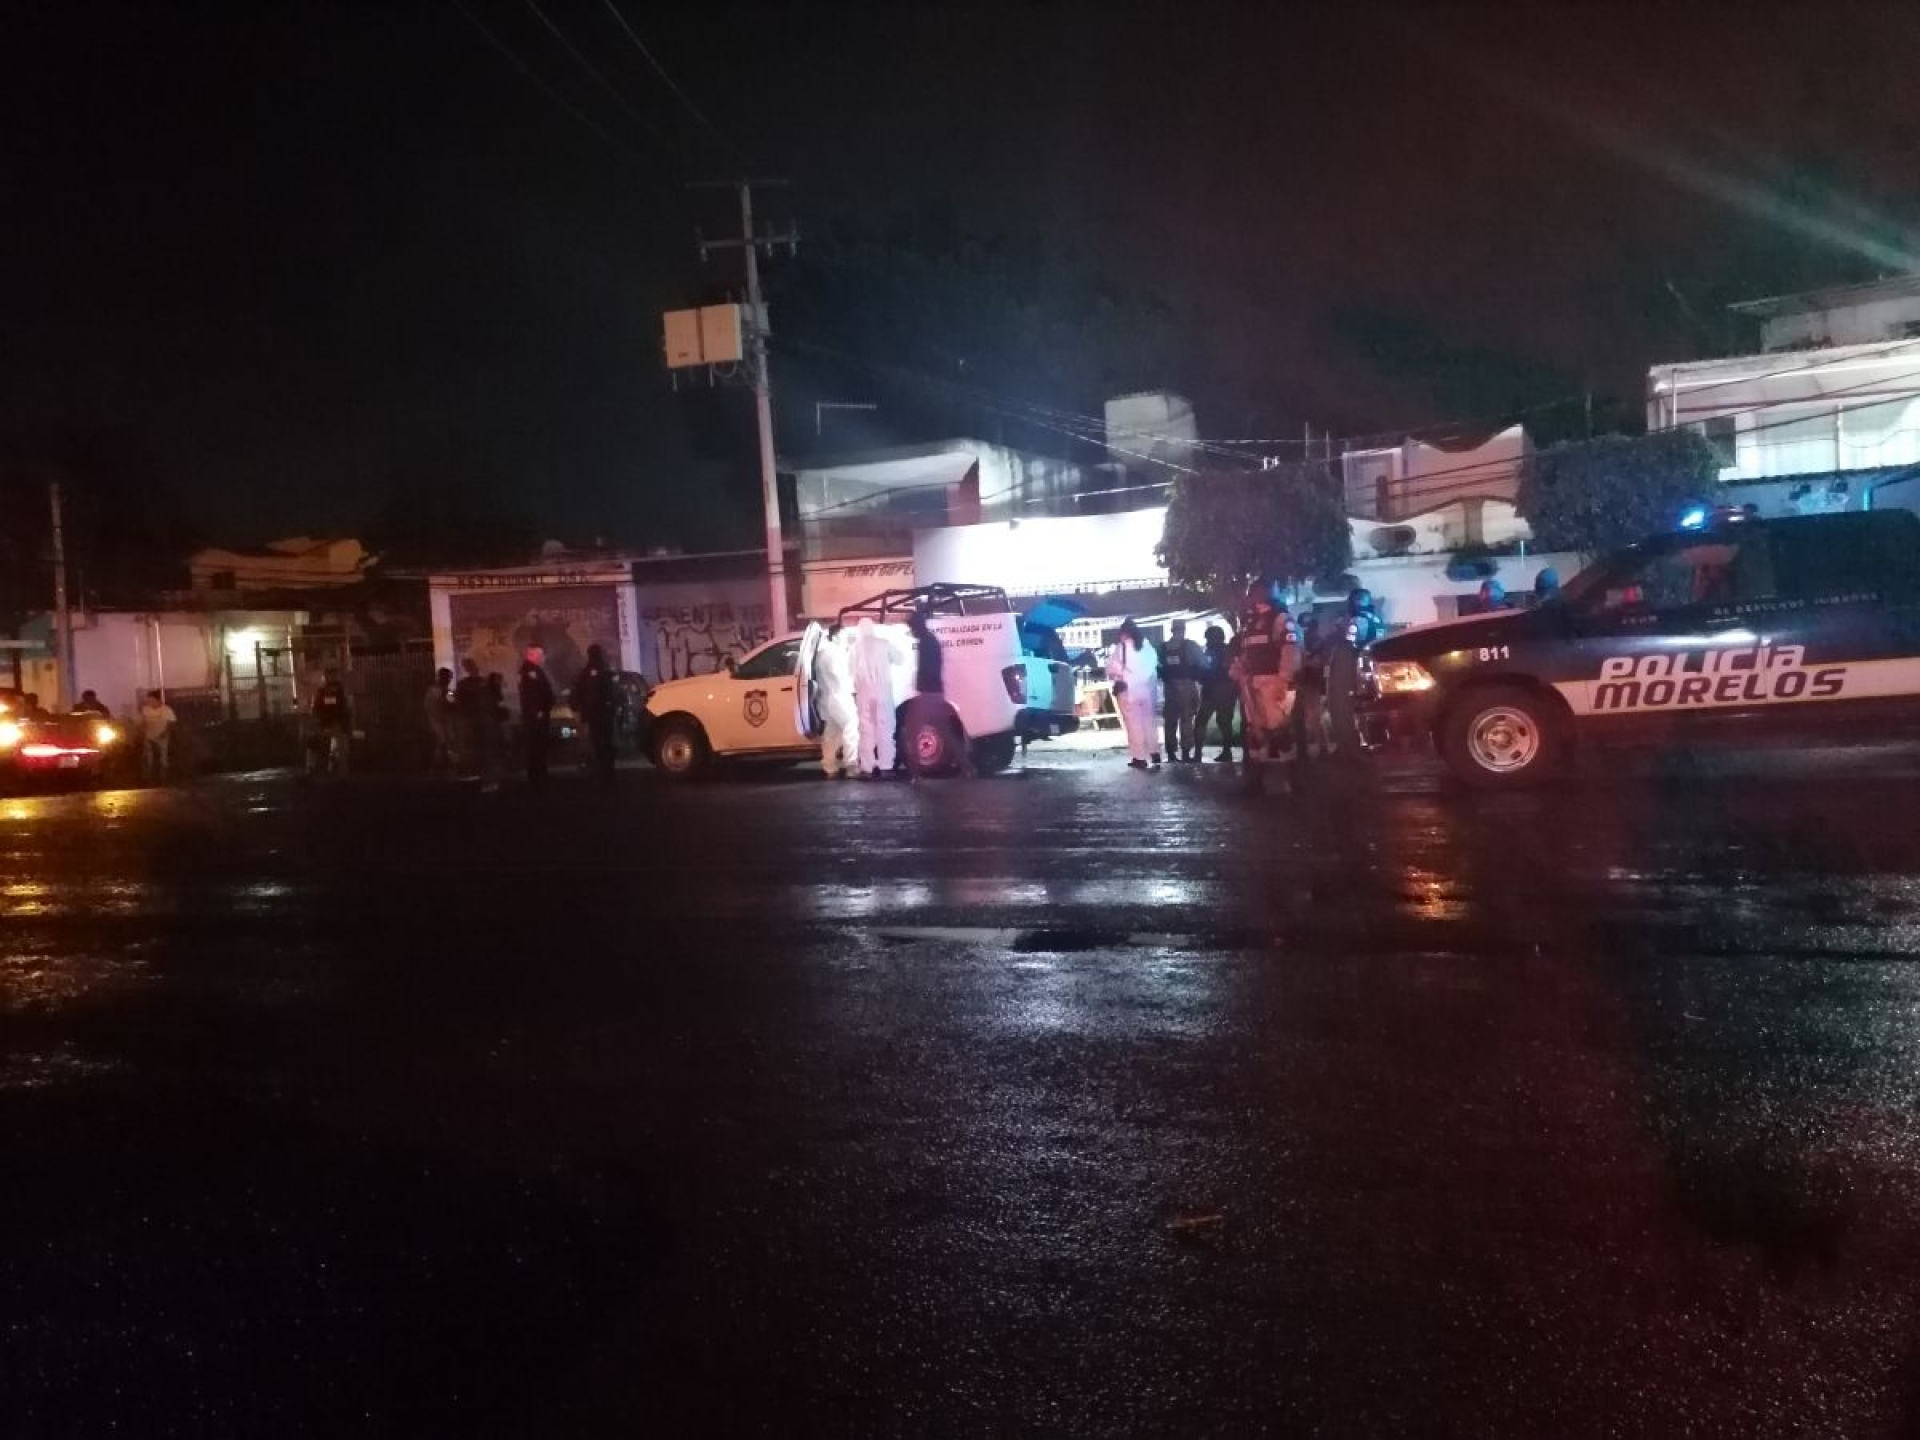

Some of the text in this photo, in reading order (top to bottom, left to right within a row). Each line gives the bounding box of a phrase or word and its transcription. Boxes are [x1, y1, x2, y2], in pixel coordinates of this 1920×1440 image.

[1479, 645, 1510, 662] 811
[1599, 645, 1805, 681] POLICIA
[1593, 668, 1847, 709] MORELOS
